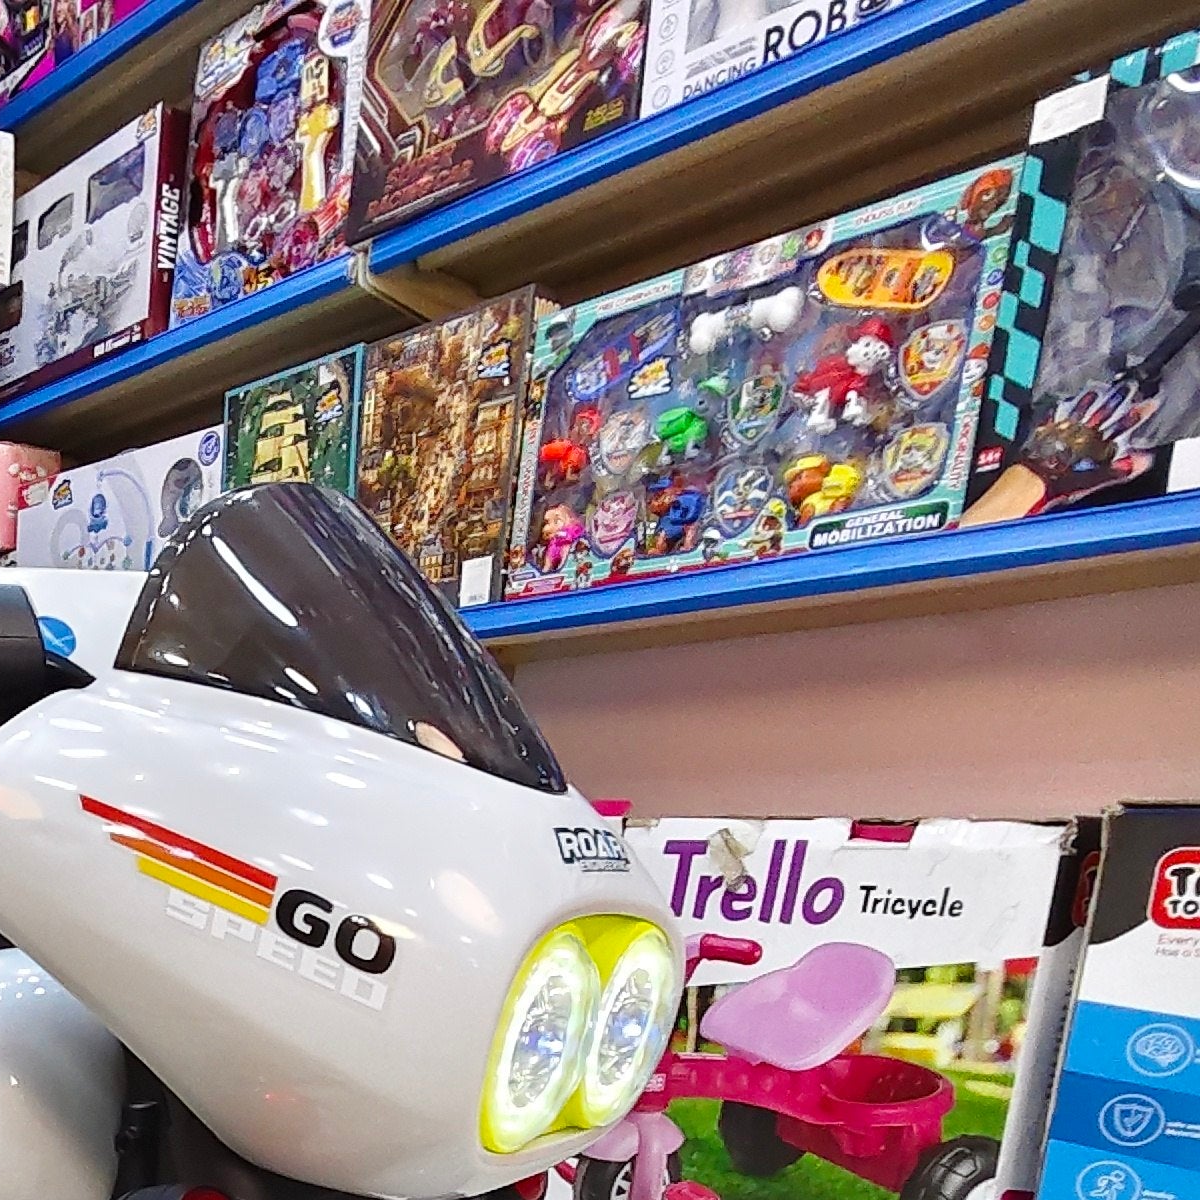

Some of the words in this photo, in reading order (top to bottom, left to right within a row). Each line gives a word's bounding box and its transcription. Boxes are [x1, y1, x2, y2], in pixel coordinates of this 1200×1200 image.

[681, 55, 757, 101] DANCING
[157, 183, 181, 270] VINTAGE
[812, 512, 942, 547] MOBILIZATION
[845, 509, 906, 529] GENERAL
[662, 839, 846, 926] Trello
[859, 884, 964, 920] Tricycle
[165, 886, 390, 1012] SPEED
[275, 888, 397, 975] GO
